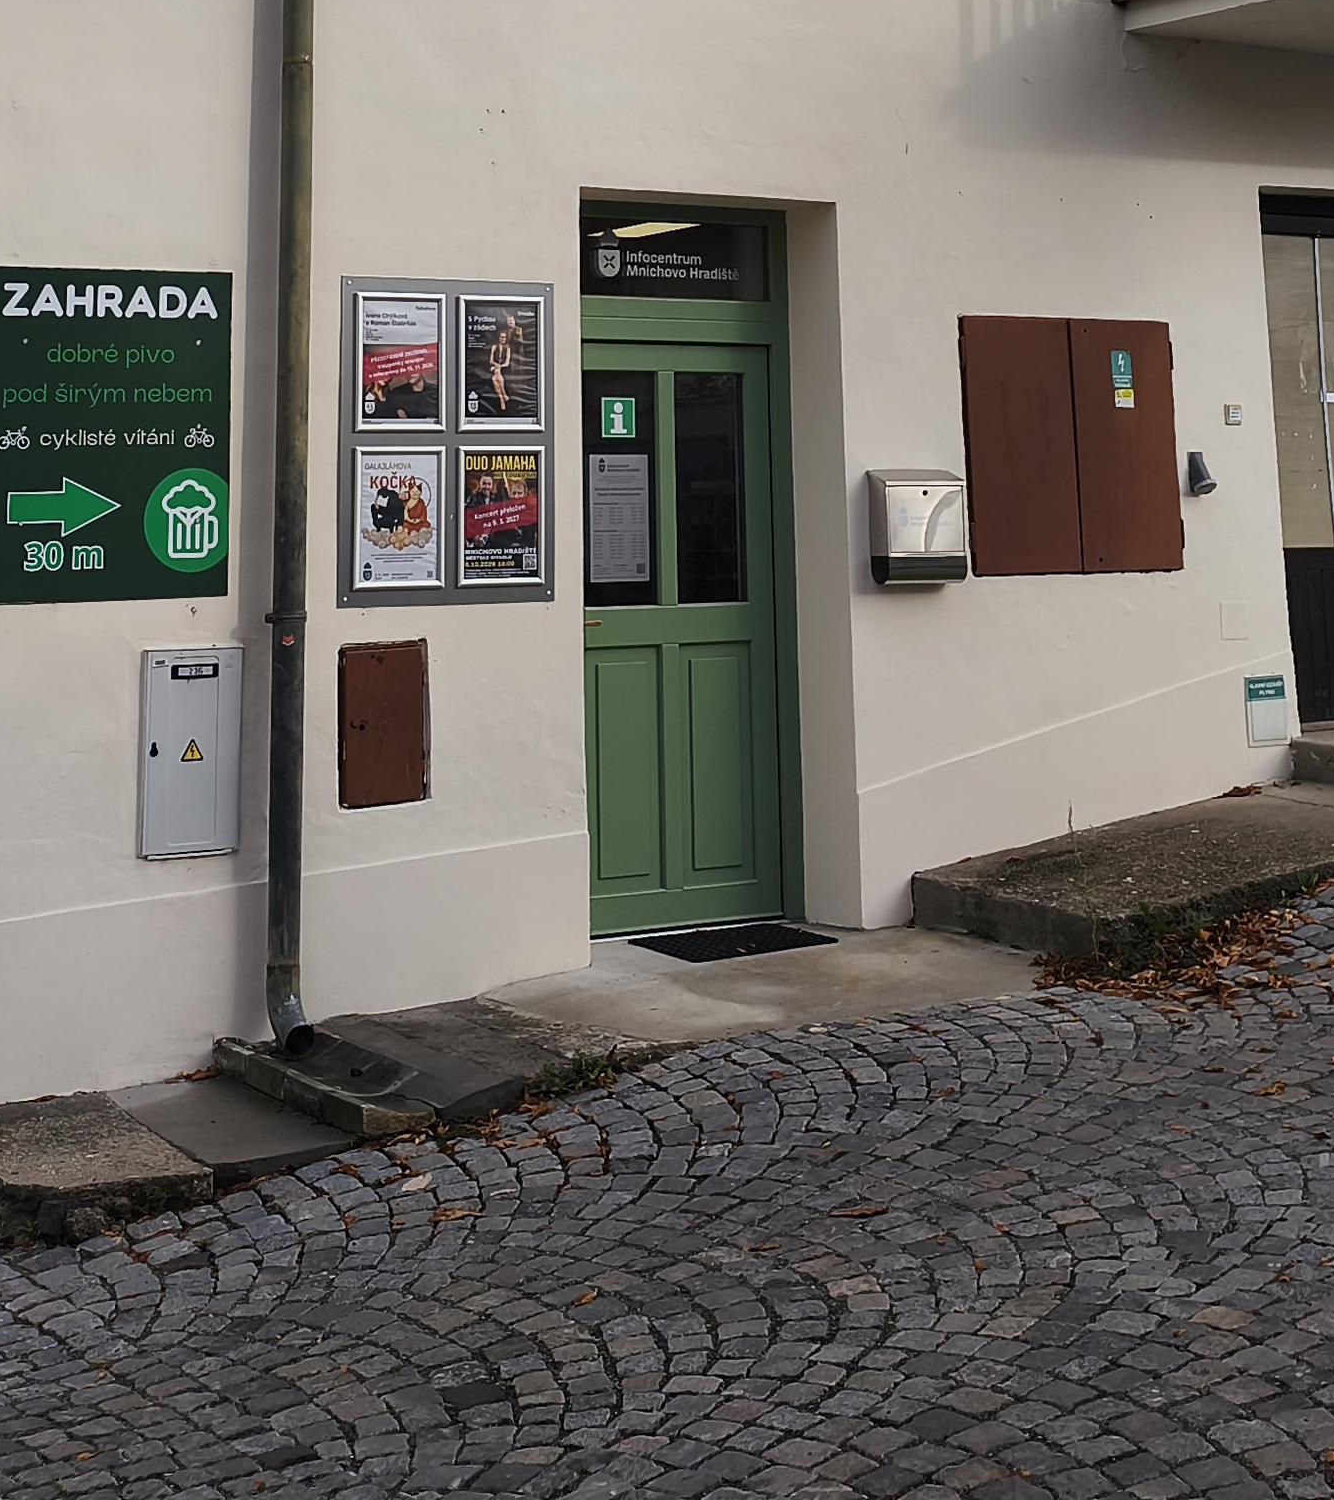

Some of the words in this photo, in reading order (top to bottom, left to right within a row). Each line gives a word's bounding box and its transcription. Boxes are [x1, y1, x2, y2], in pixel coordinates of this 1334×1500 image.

[626, 250, 702, 266] Infocentrum
[626, 264, 687, 279] Mnichovo
[689, 267, 739, 281] Hradiště
[2, 282, 218, 320] ZAHRADA
[46, 342, 118, 364] dobré
[126, 344, 176, 369] pivo
[2, 382, 48, 409] pod
[54, 382, 126, 409] širým
[133, 382, 213, 403] nebem
[39, 429, 116, 451] cyklisté
[123, 428, 175, 446] vítáni
[465, 455, 489, 471] DUO
[490, 455, 536, 471] JAMAHA
[370, 471, 417, 489] KOČKA
[23, 540, 65, 573] 30
[71, 545, 104, 571] m
